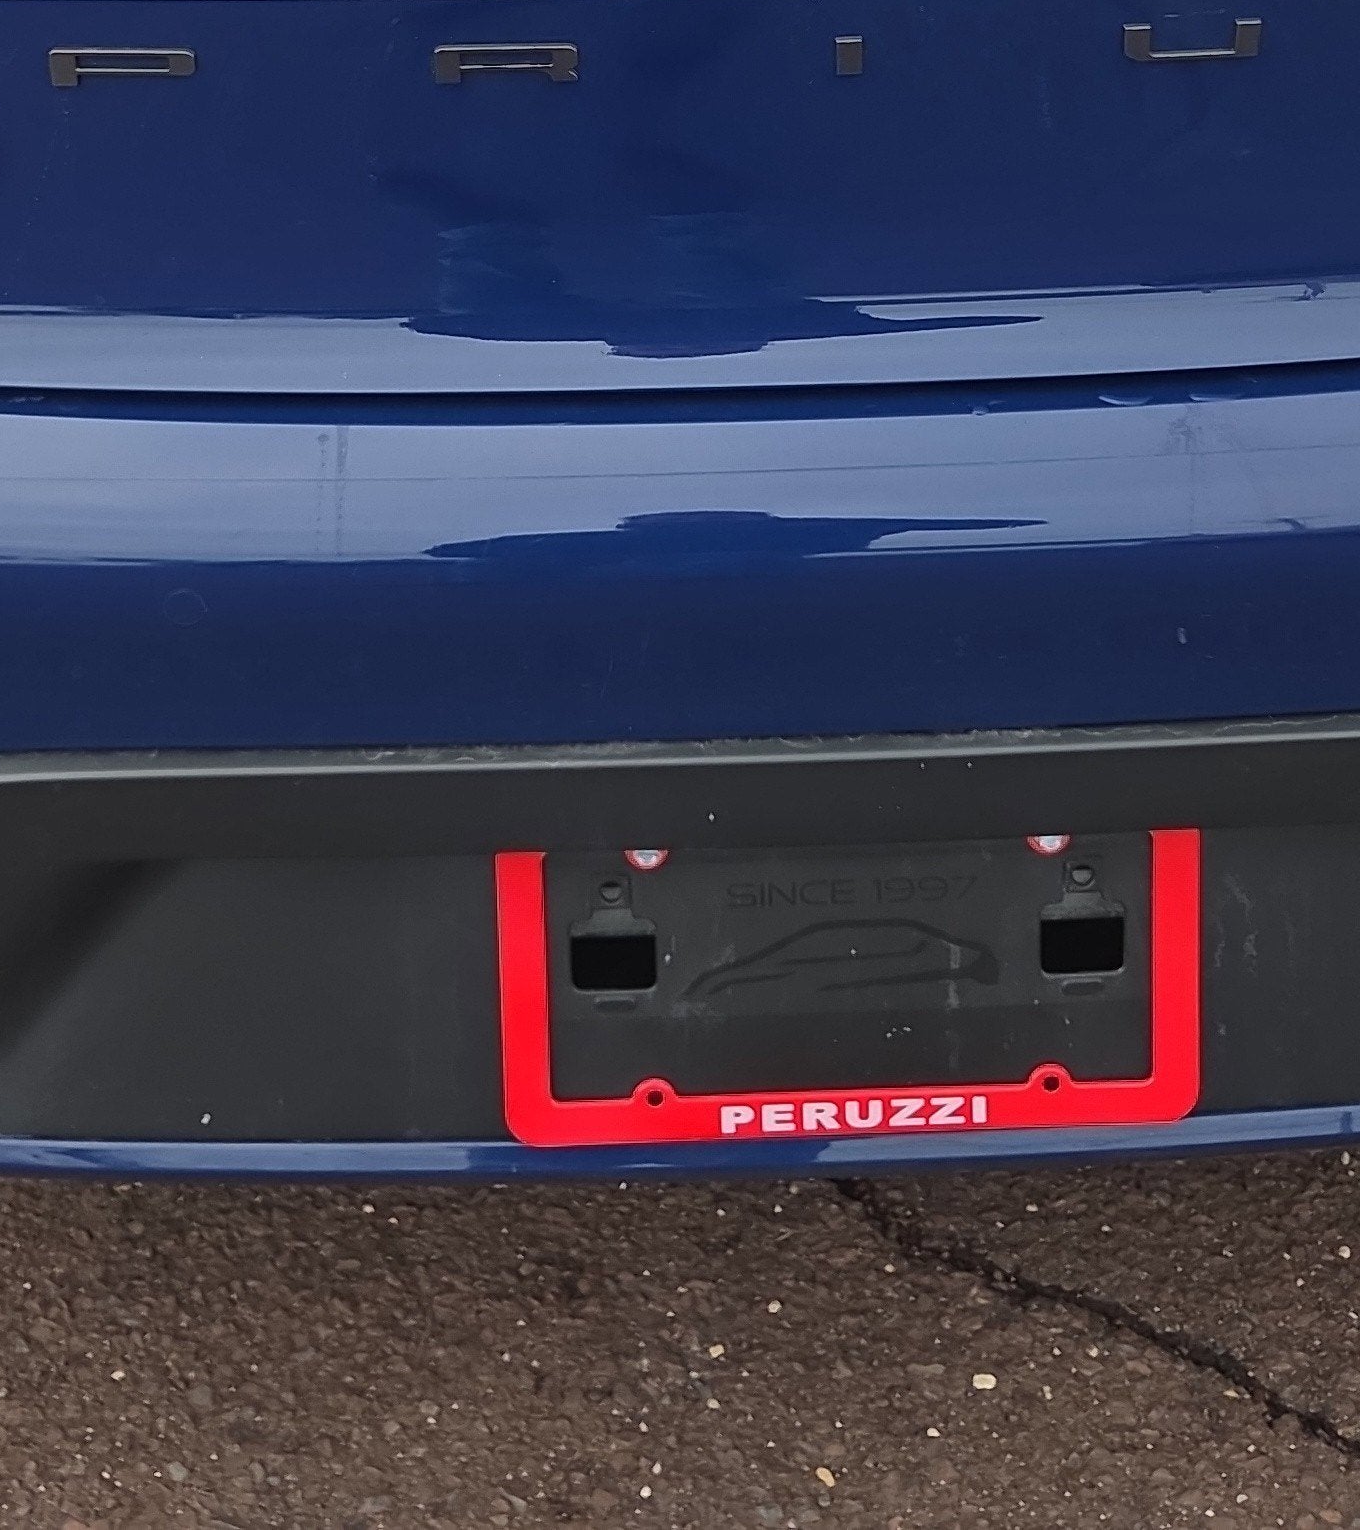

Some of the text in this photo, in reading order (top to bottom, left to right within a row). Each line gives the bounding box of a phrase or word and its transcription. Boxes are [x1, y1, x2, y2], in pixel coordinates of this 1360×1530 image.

[727, 876, 978, 907] SINCE 1997
[720, 1095, 987, 1134] PERUZZI
